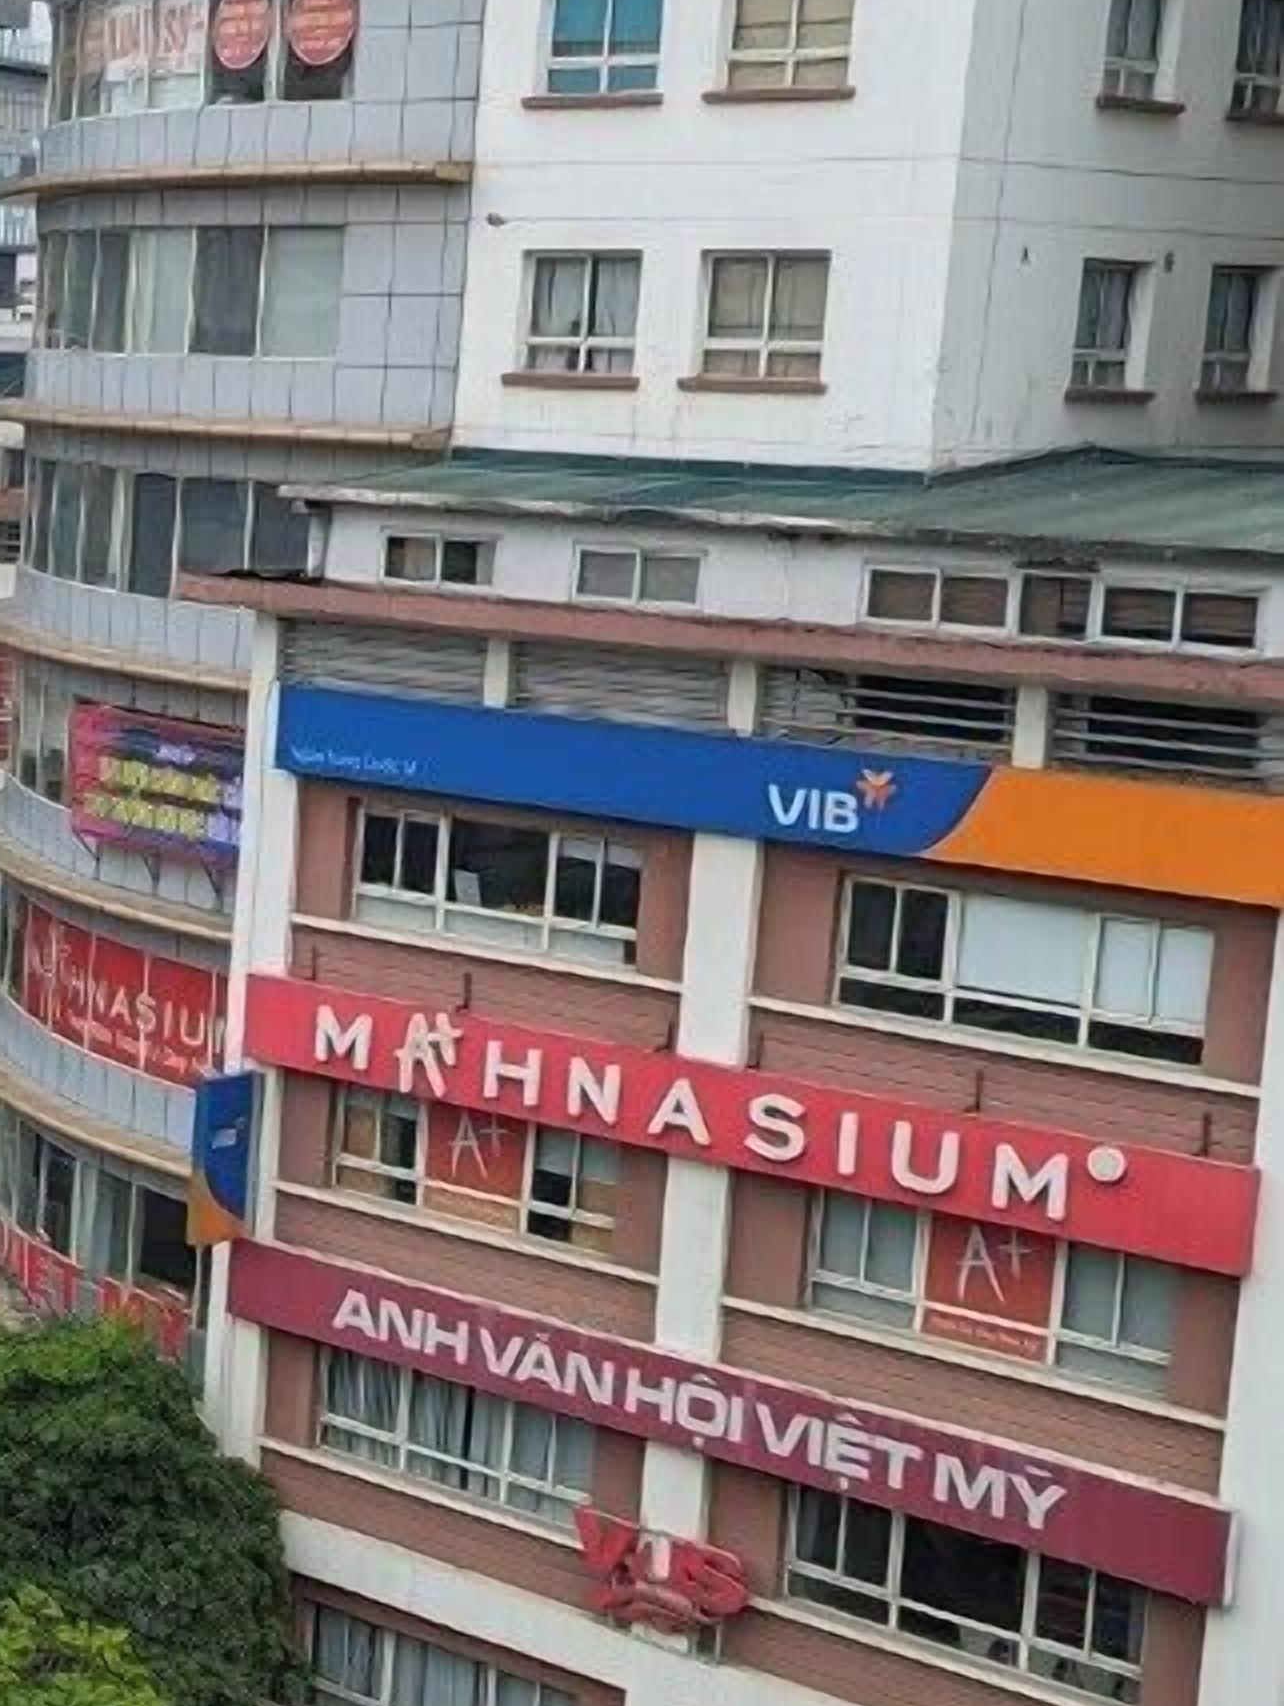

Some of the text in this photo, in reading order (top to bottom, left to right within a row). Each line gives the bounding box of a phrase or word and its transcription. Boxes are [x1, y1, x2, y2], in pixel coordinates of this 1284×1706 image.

[768, 782, 859, 834] VIB
[333, 1288, 469, 1366] ANH
[479, 1331, 614, 1405] VĂN
[623, 1368, 744, 1449] HỘI
[754, 1402, 925, 1491] VIỆT
